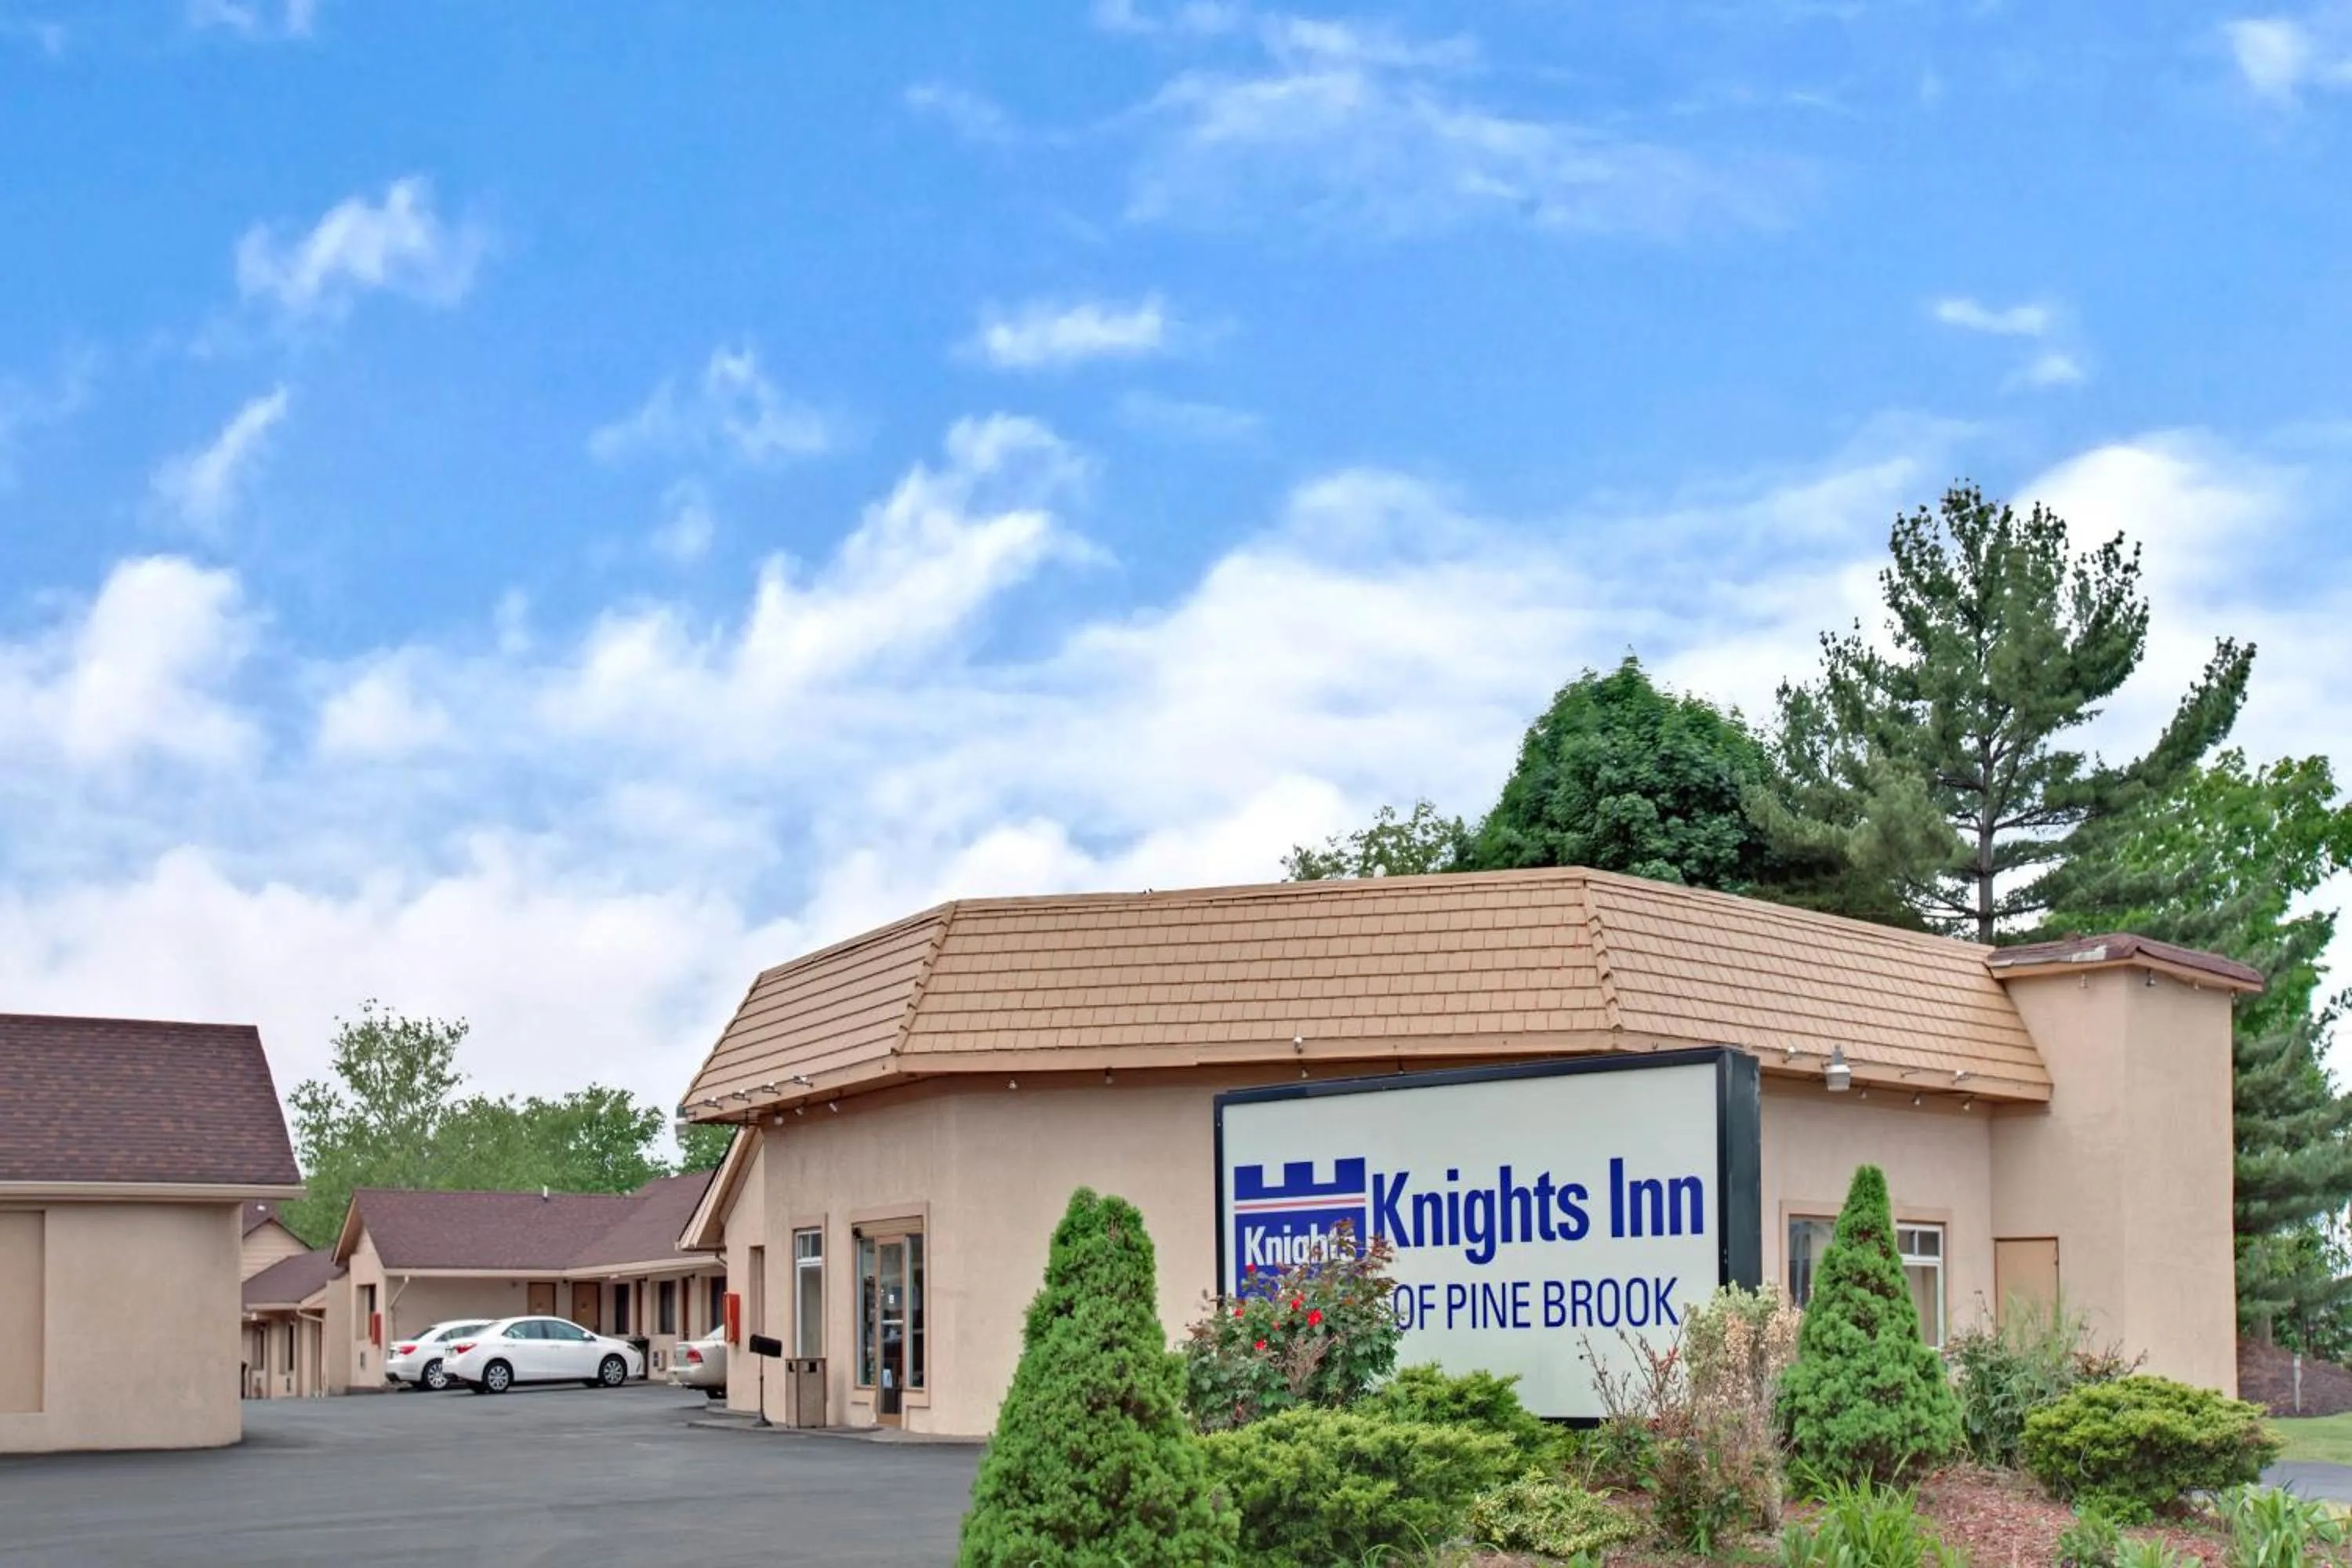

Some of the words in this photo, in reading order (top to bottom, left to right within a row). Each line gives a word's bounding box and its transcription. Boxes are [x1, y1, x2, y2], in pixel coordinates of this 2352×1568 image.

[1371, 1165, 1590, 1265] Knights
[1610, 1157, 1704, 1238] Inn
[1393, 1283, 1436, 1330] OF
[1446, 1281, 1530, 1330] PINE
[1543, 1276, 1679, 1328] BROOK
